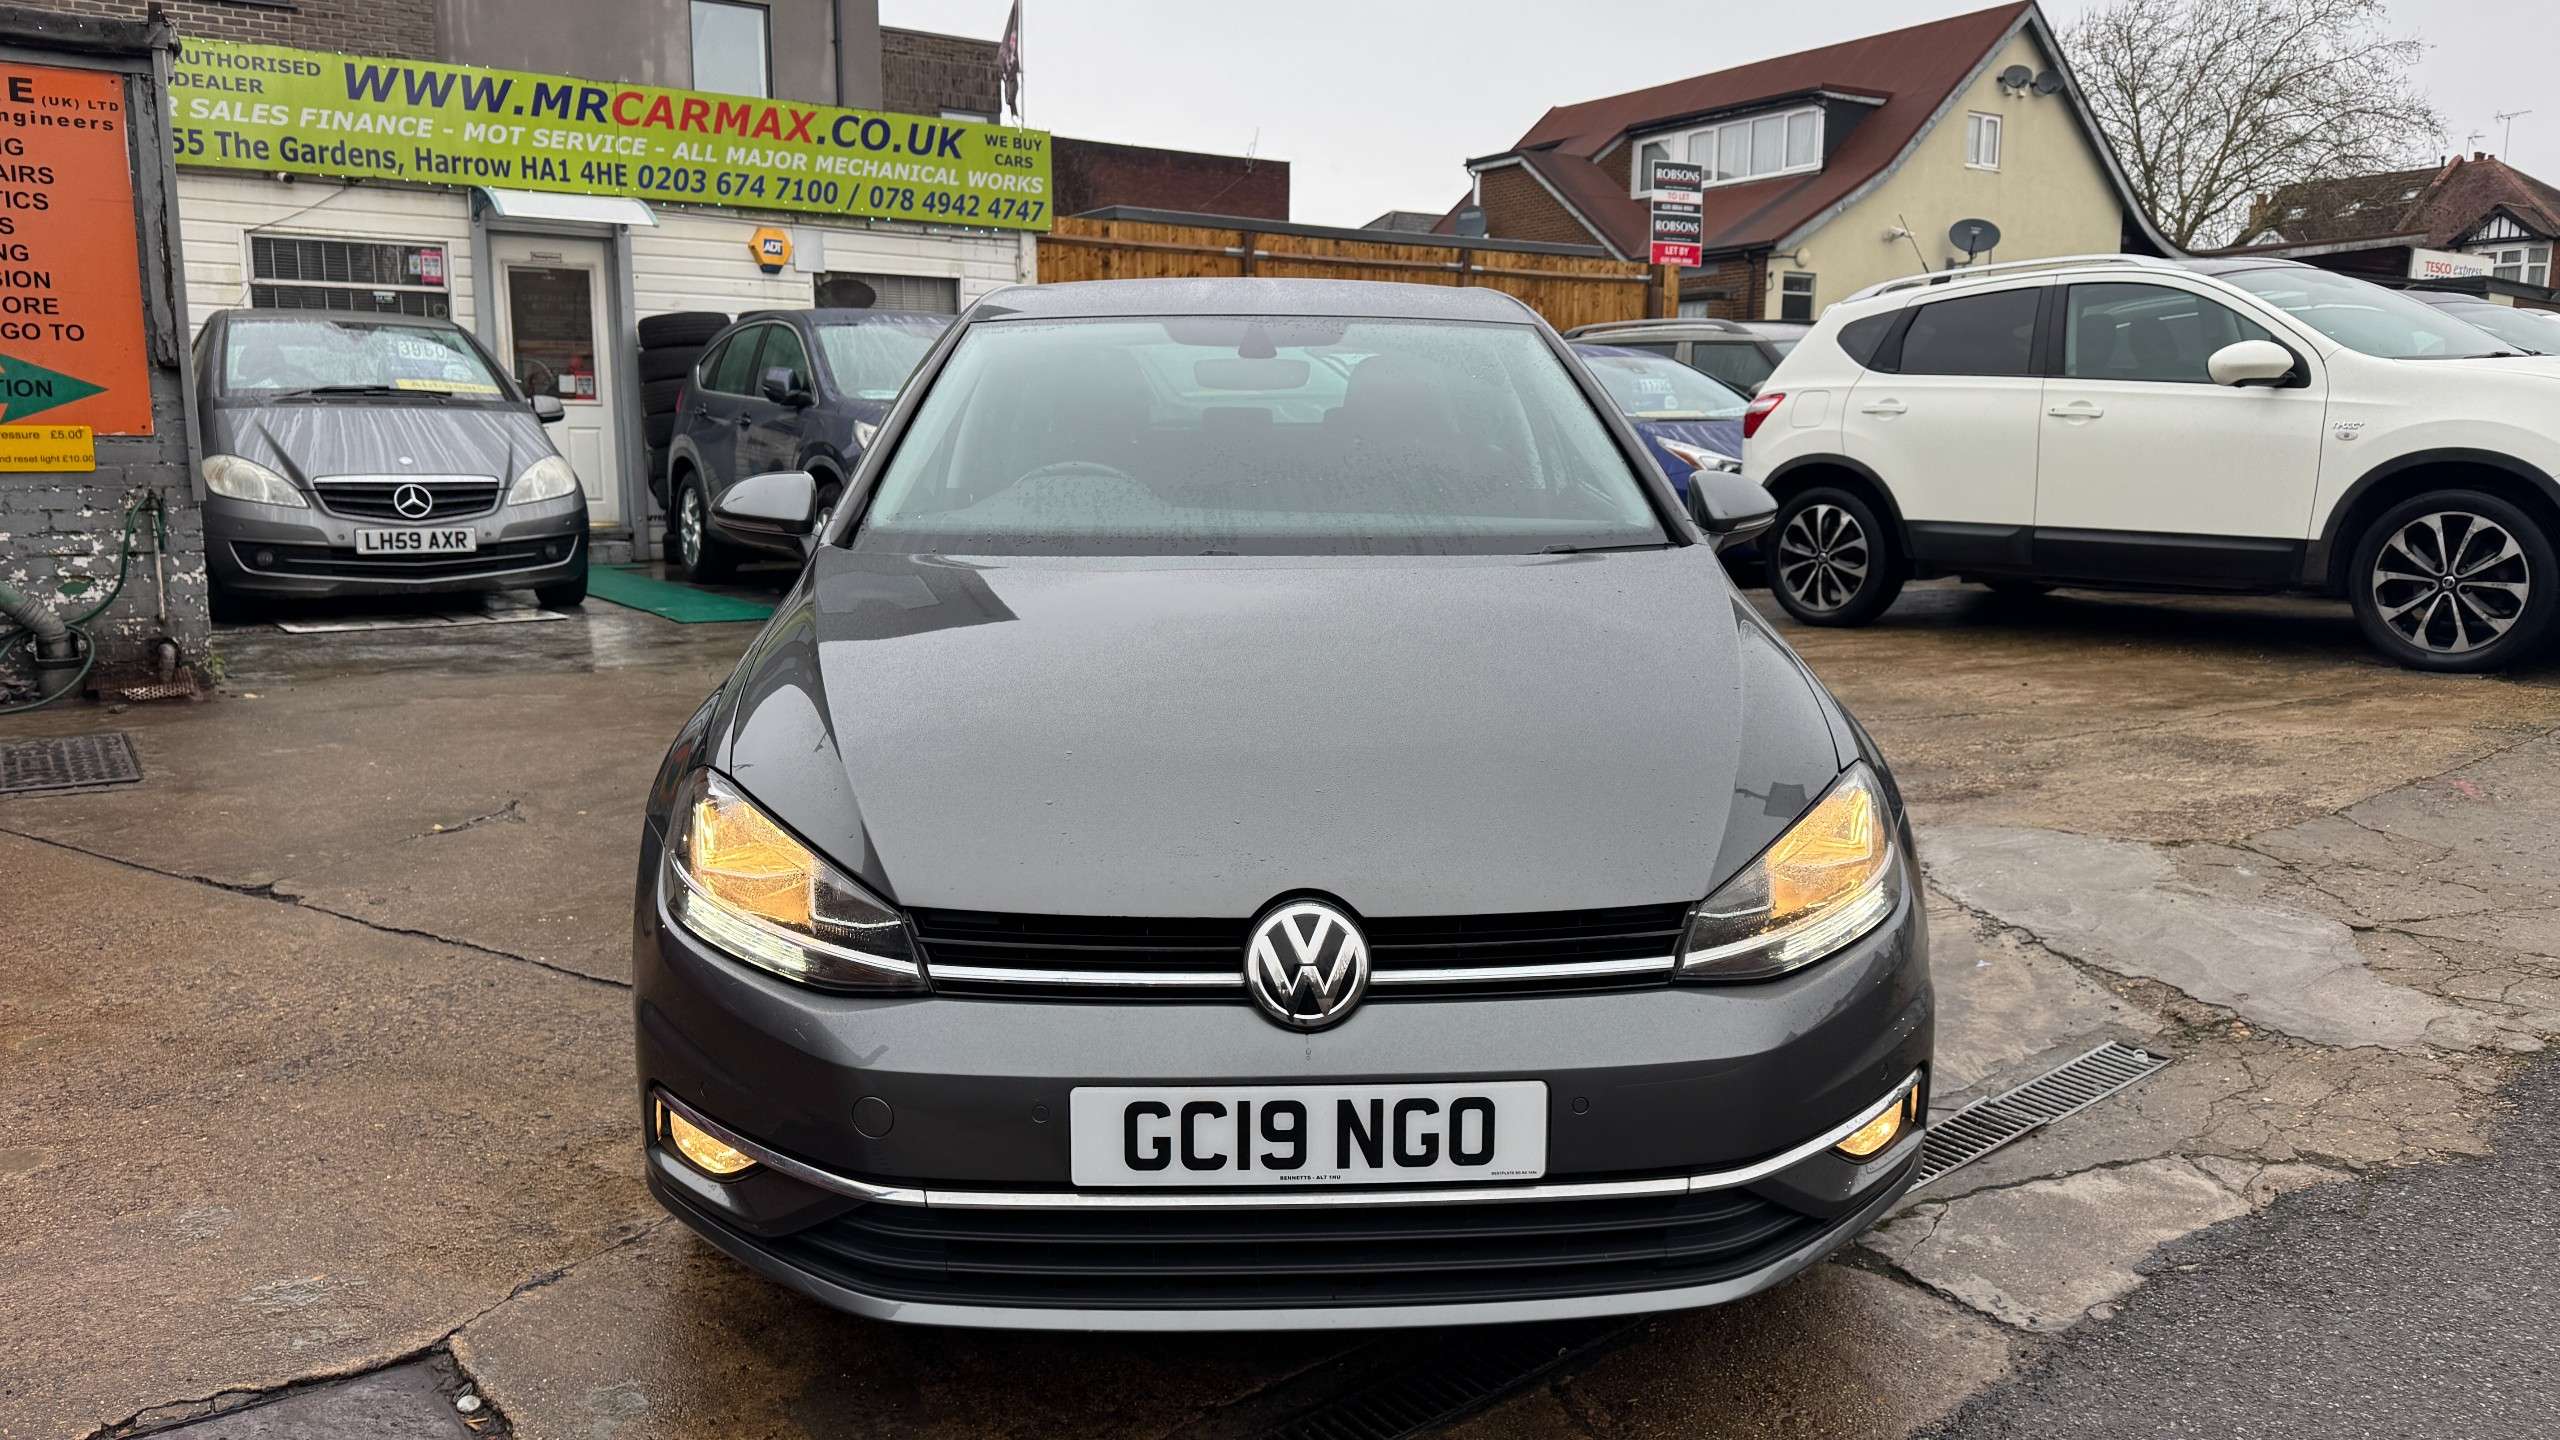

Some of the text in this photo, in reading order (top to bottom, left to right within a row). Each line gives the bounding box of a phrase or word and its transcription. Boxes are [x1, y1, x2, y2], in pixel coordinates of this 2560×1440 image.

[175, 71, 265, 95] DEALER
[41, 95, 80, 110] (UK)
[87, 99, 119, 112] LTD
[344, 62, 967, 160] WWW.MRCARMAX.CO.UK
[0, 110, 114, 131] ngineers
[0, 137, 24, 156] G
[189, 98, 289, 126] SALES
[299, 107, 434, 139] FINANCE
[464, 122, 526, 146] MOT
[532, 127, 648, 157] SERVICE
[672, 141, 717, 163] ALL
[725, 146, 808, 172] MAJOR
[815, 154, 960, 186] MECHANICAL
[968, 170, 1044, 195] WORKS
[984, 133, 1042, 152] WE BUY
[994, 153, 1034, 169] CARS
[213, 130, 270, 161] The
[279, 135, 404, 176] Gardens,
[414, 146, 511, 179] Harrow
[521, 155, 571, 183] HA1
[580, 160, 628, 188] 4HE
[638, 164, 707, 194] 0203
[716, 170, 766, 199] 674
[775, 176, 839, 205] 7100
[846, 182, 860, 210] /
[869, 185, 915, 212] 078
[922, 190, 980, 218] 4942
[987, 197, 1045, 222] 4747
[1655, 167, 1700, 183] ROBSONS
[0, 190, 49, 211] ICS
[1655, 219, 1700, 234] ROBSONS
[764, 240, 782, 253] ADT
[1664, 245, 1678, 256] LET
[2424, 261, 2452, 274] TESCO
[0, 269, 51, 289] ION
[2, 296, 60, 315] ORE
[0, 322, 85, 342] GO TO
[0, 378, 53, 398] ION
[0, 431, 40, 440] essure
[14, 455, 38, 463] reset
[40, 455, 60, 465] light
[365, 531, 468, 551] LH59 AXR
[1123, 1096, 1496, 1172] GC19 NGO
